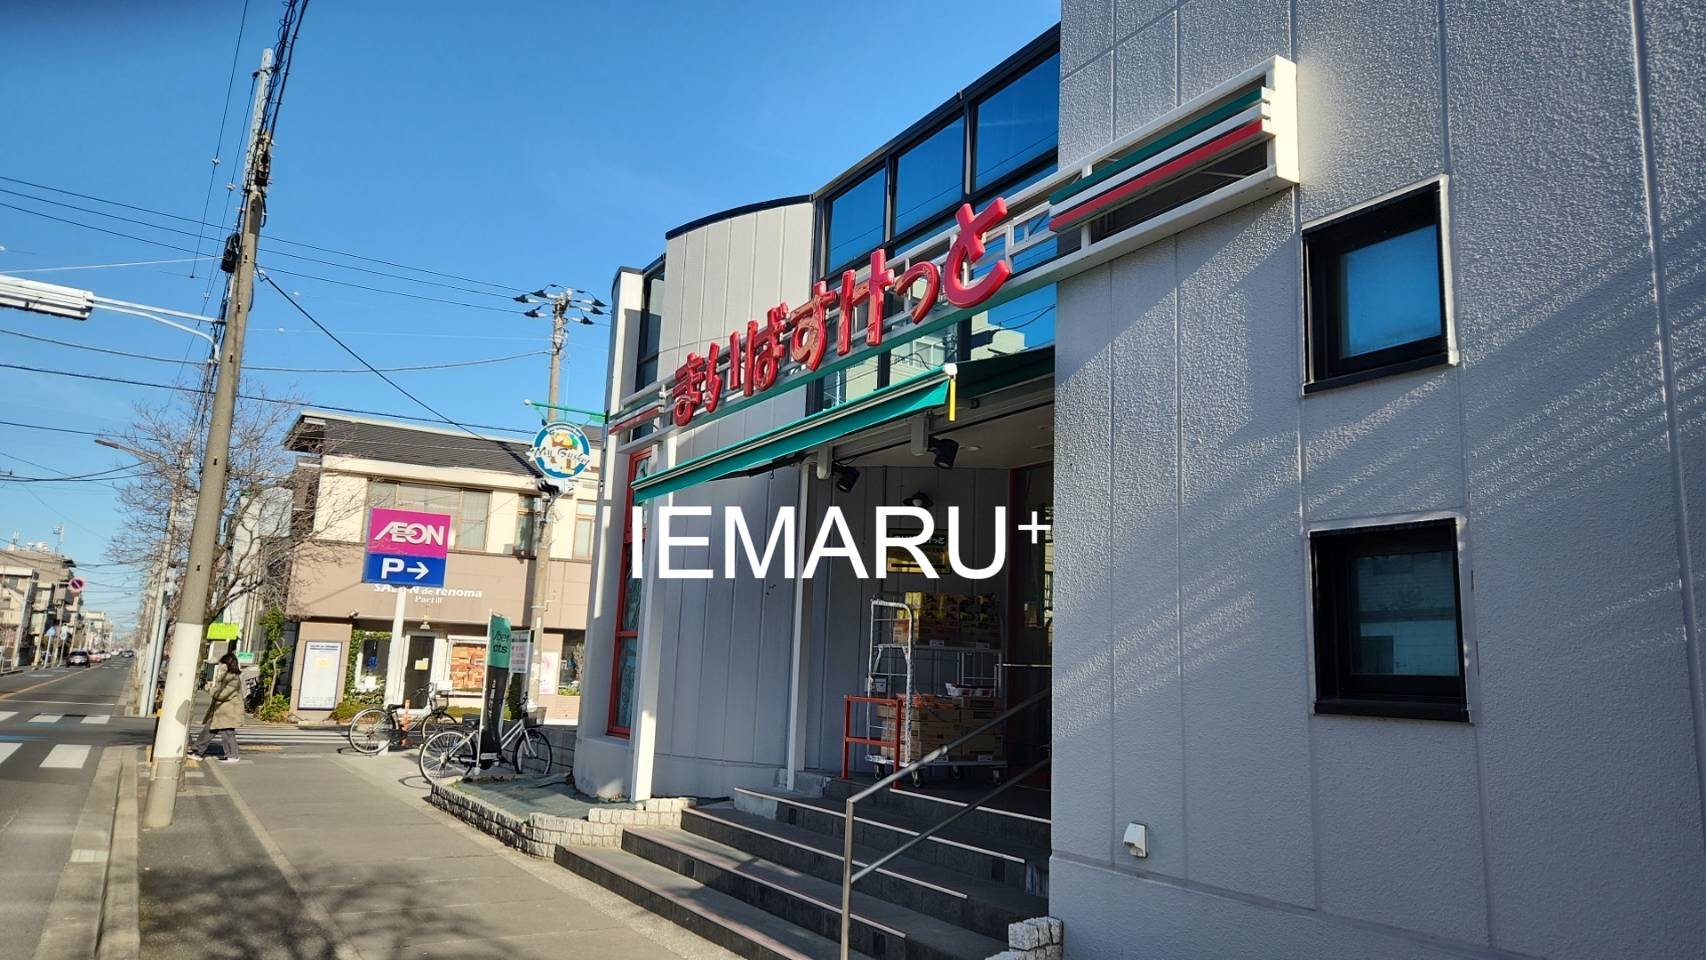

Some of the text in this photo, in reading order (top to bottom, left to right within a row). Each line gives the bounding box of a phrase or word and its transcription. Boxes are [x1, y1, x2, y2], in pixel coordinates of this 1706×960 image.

[673, 197, 1011, 427] まいばすけっと
[381, 557, 405, 580] P
[373, 584, 419, 595] SALN
